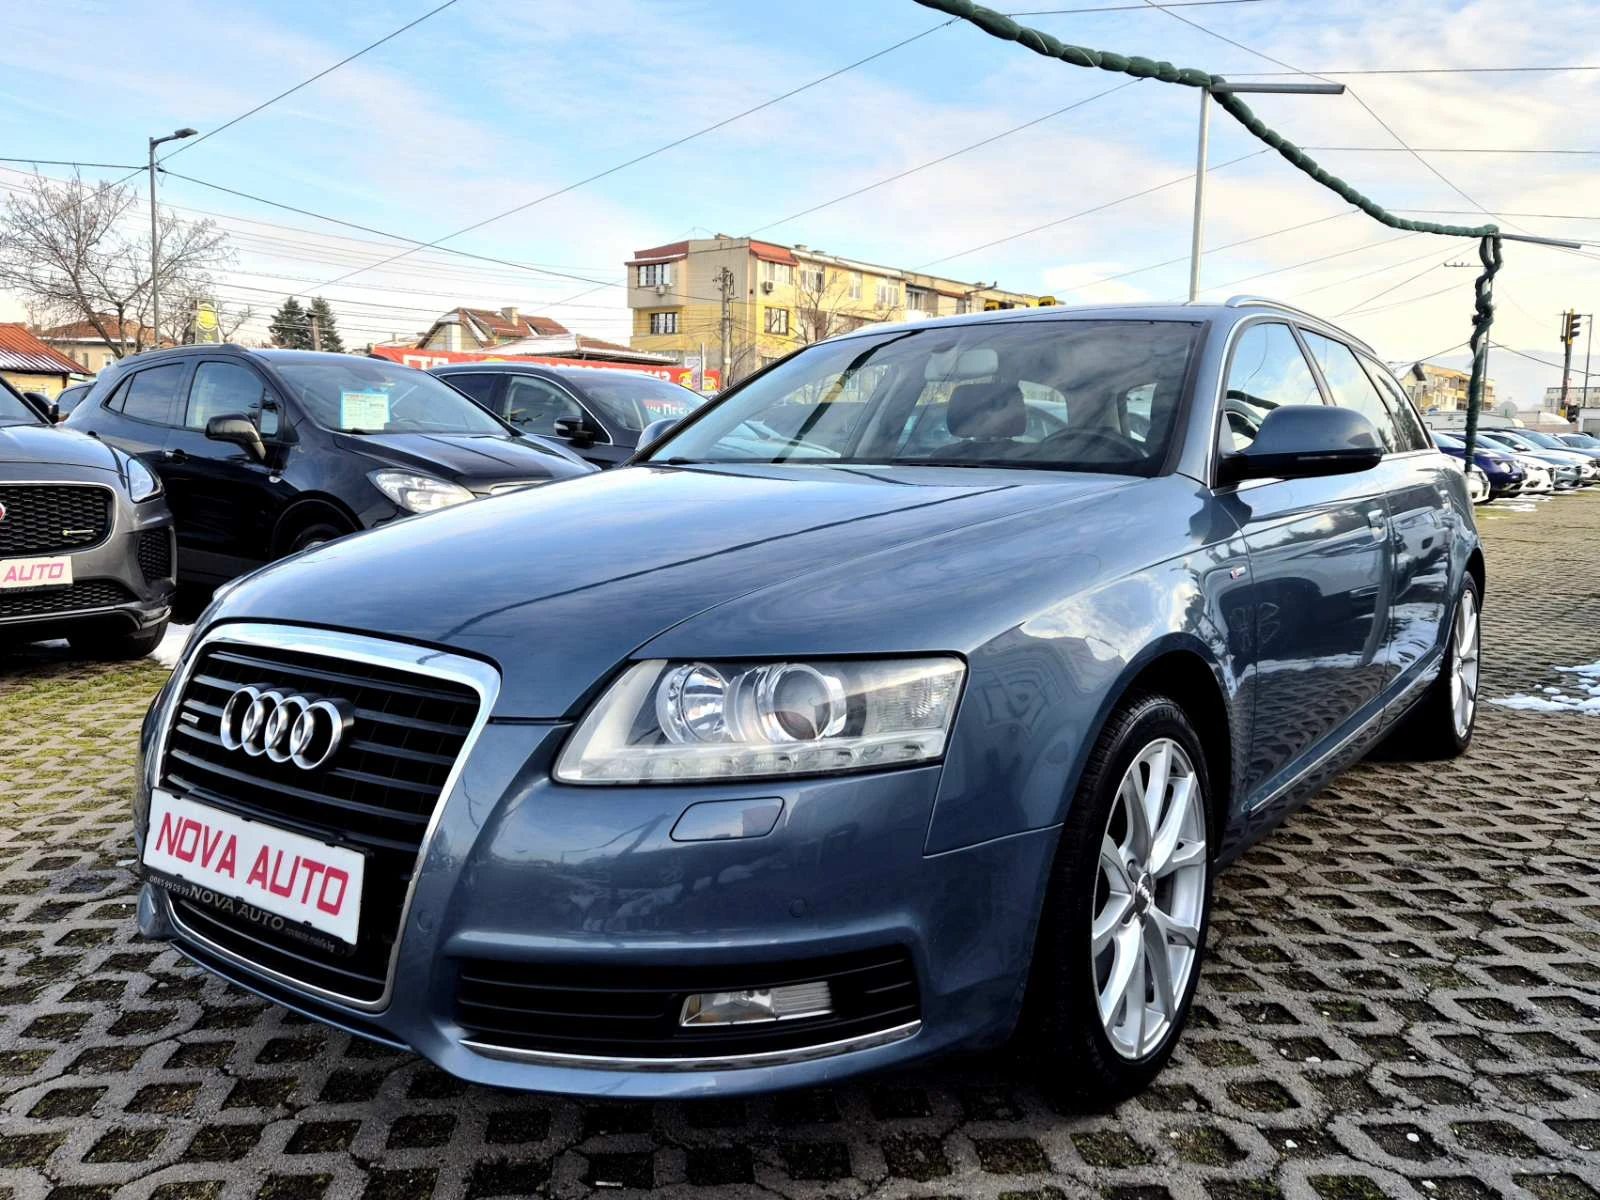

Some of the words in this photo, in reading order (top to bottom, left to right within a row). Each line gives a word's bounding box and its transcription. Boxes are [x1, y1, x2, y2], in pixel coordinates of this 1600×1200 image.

[3, 563, 64, 582] AUTO
[155, 812, 237, 879] NOVA
[246, 845, 349, 916] AUTO
[189, 884, 235, 913] NOVA
[237, 904, 285, 931] AUTO
